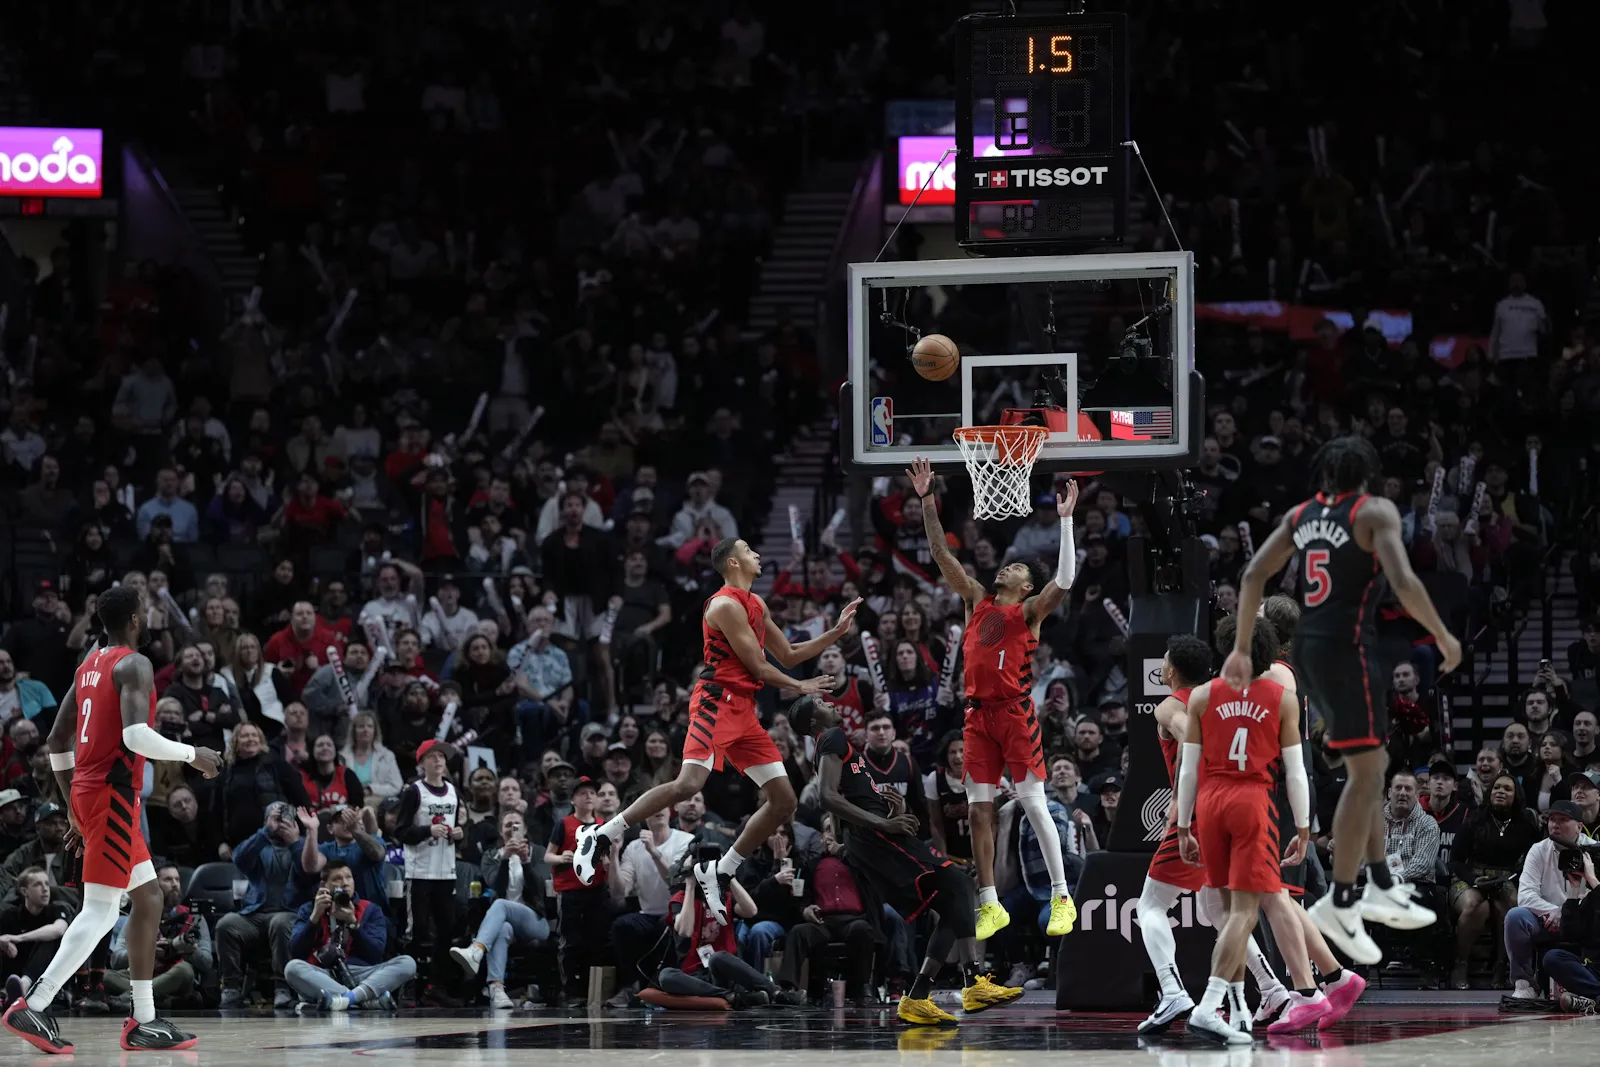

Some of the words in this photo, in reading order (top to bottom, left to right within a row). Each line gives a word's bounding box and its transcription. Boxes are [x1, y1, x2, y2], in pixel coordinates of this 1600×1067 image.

[1028, 36, 1072, 74] 1.5
[0, 136, 97, 184] oda
[1010, 166, 1109, 188] TISSOT
[1293, 519, 1350, 550] QUICKLEY
[1304, 548, 1332, 608] 5
[998, 649, 1006, 670] 1
[80, 697, 92, 744] 2
[1215, 700, 1270, 723] THYBULLE
[1228, 727, 1249, 772] 4
